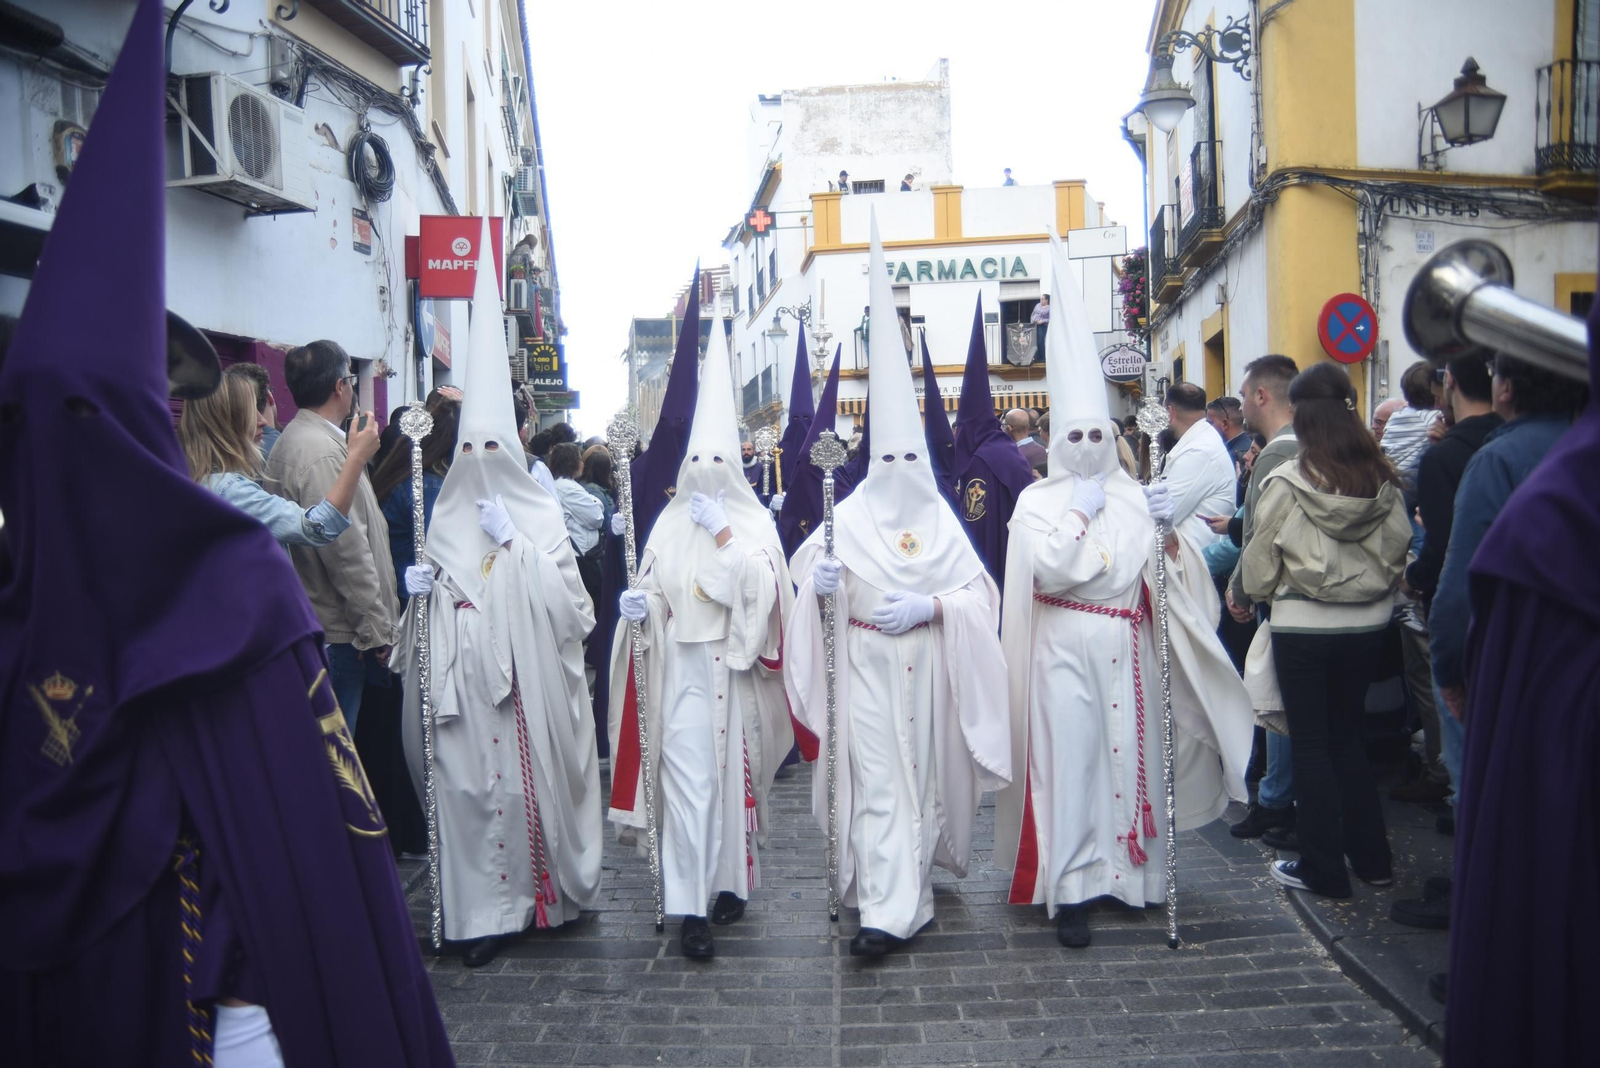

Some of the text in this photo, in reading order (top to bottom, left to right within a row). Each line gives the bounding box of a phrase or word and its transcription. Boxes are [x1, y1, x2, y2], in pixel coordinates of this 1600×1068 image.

[428, 259, 479, 271] MAPF
[886, 255, 1028, 283] FARMACIA
[1108, 355, 1142, 365] Estrella
[1109, 364, 1141, 375] Galicia
[528, 378, 564, 386] EALEJO
[990, 384, 1014, 393] LEJO
